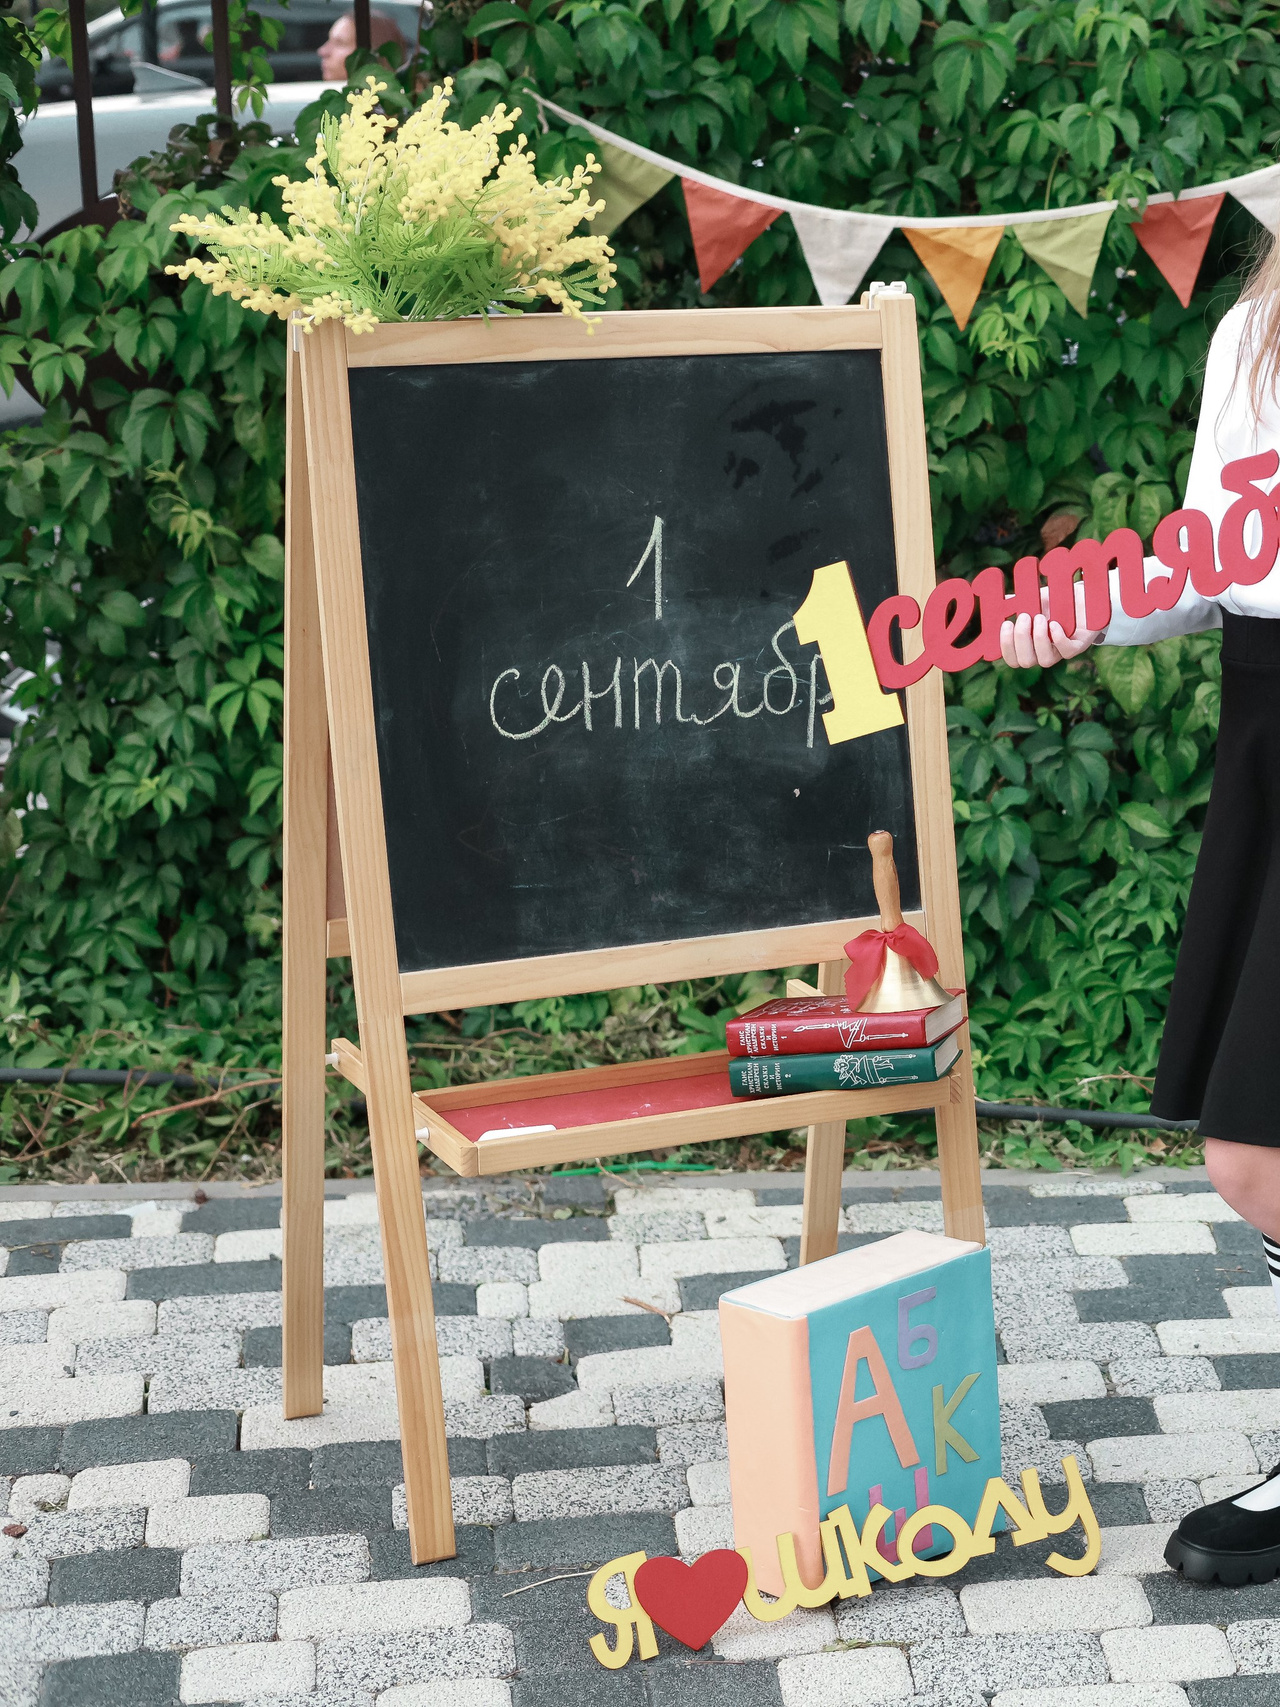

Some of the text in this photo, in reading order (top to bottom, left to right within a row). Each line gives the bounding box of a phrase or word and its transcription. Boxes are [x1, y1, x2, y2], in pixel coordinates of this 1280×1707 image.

[627, 515, 663, 620] 1
[793, 560, 905, 746] 1
[489, 619, 835, 748] сентябр
[751, 1023, 759, 1053] АНДЕРСЕН
[759, 1025, 767, 1050] СКАЗКИ
[771, 1023, 780, 1051] ИСТОРИИ
[747, 1062, 756, 1094] ХРИСТИАН
[753, 1062, 762, 1093] АНДЕРСЕН
[762, 1065, 770, 1089] СКАЗКИ
[774, 1062, 783, 1090] ИСТОРИИ
[897, 1287, 938, 1370] Б
[827, 1325, 920, 1497] А
[932, 1372, 981, 1476] К
[735, 1455, 1101, 1622] школу
